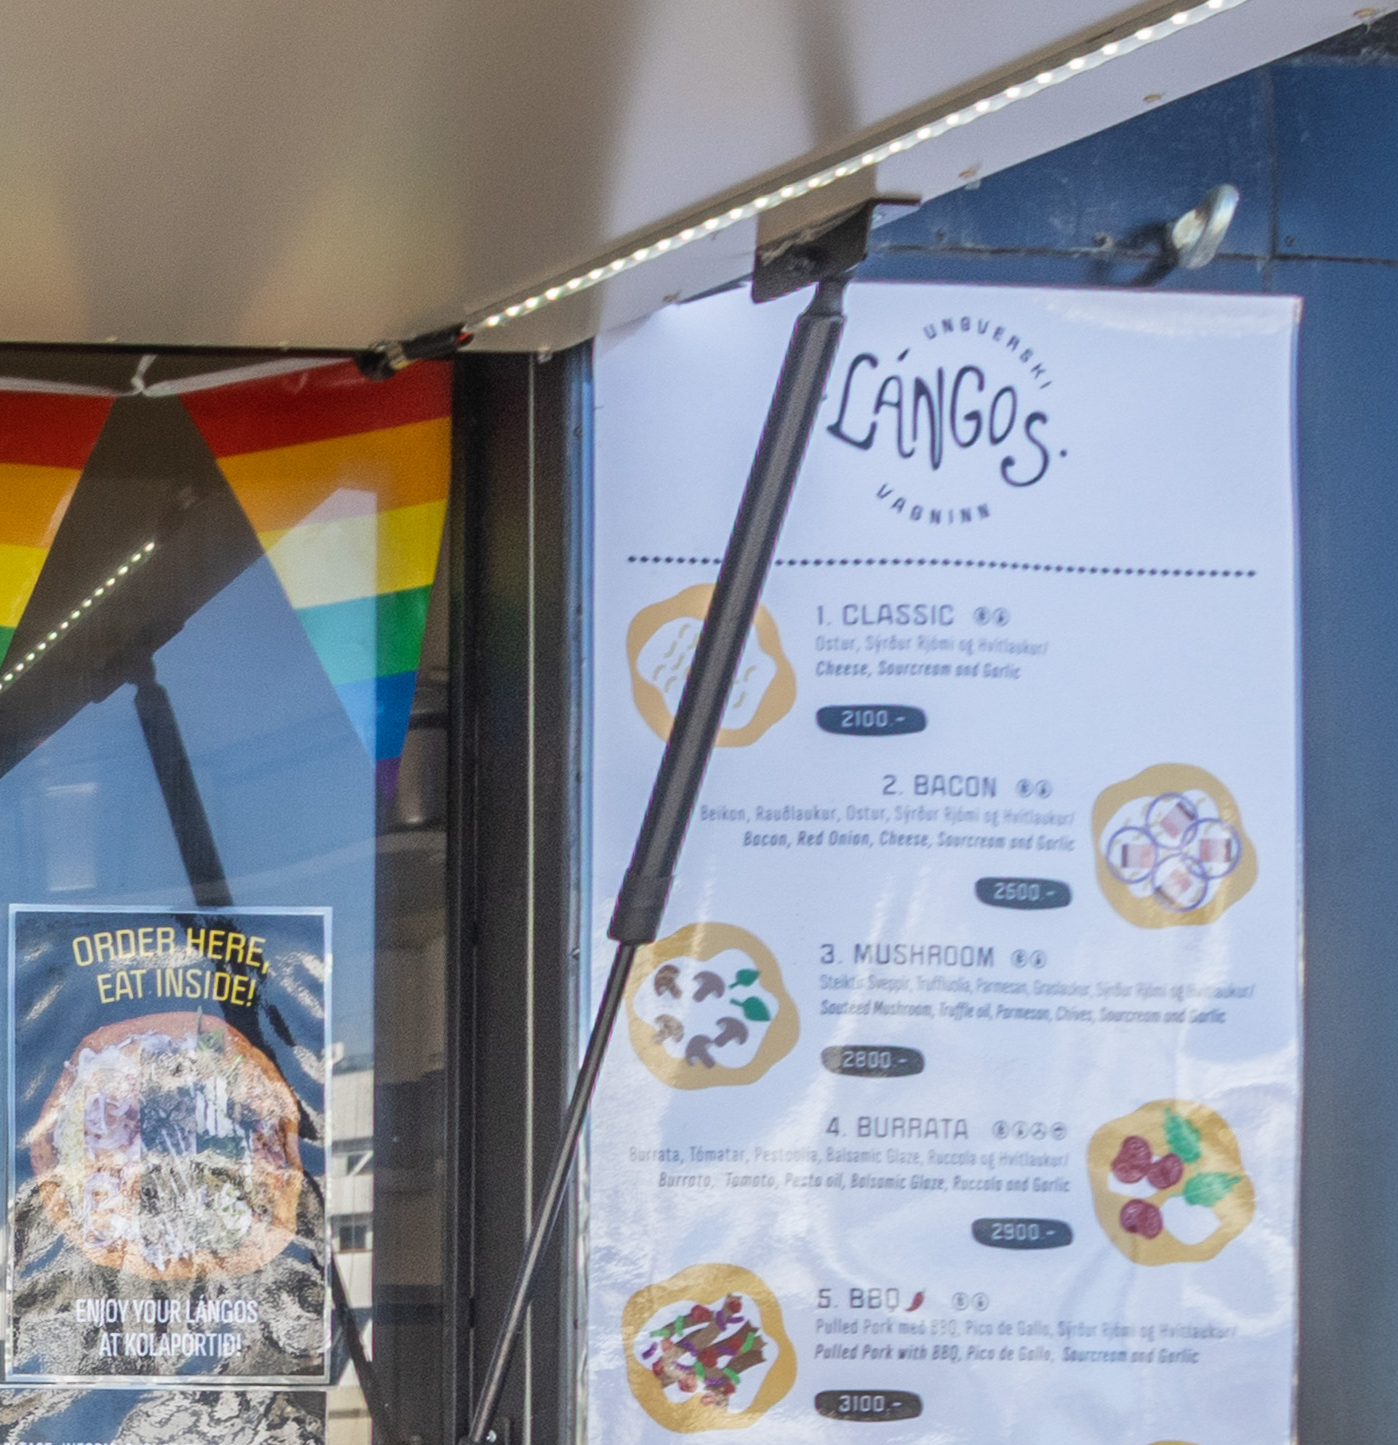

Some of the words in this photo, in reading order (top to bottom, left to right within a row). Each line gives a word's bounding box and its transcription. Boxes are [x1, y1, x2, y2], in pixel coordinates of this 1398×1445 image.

[877, 482, 992, 526] VAGNINN
[816, 604, 833, 627] 1.
[843, 604, 956, 628] CLASSIC
[955, 661, 979, 679] and
[983, 662, 1022, 681] Garlic
[882, 775, 903, 796] 2.
[914, 775, 997, 797] BACON
[72, 927, 176, 967] ORDER
[186, 927, 269, 974] HERE,
[820, 944, 842, 966] 3.
[854, 944, 995, 967] MUSHROOM
[97, 969, 146, 1004] EAT
[157, 969, 256, 1007] INSIDE!
[826, 1118, 848, 1139] 4.
[857, 1117, 969, 1139] BURRATA
[818, 1289, 839, 1310] 5.
[850, 1289, 900, 1312] BBQ
[76, 1299, 128, 1328] ENJOY
[132, 1299, 181, 1324] YOUR
[99, 1333, 122, 1357] AT
